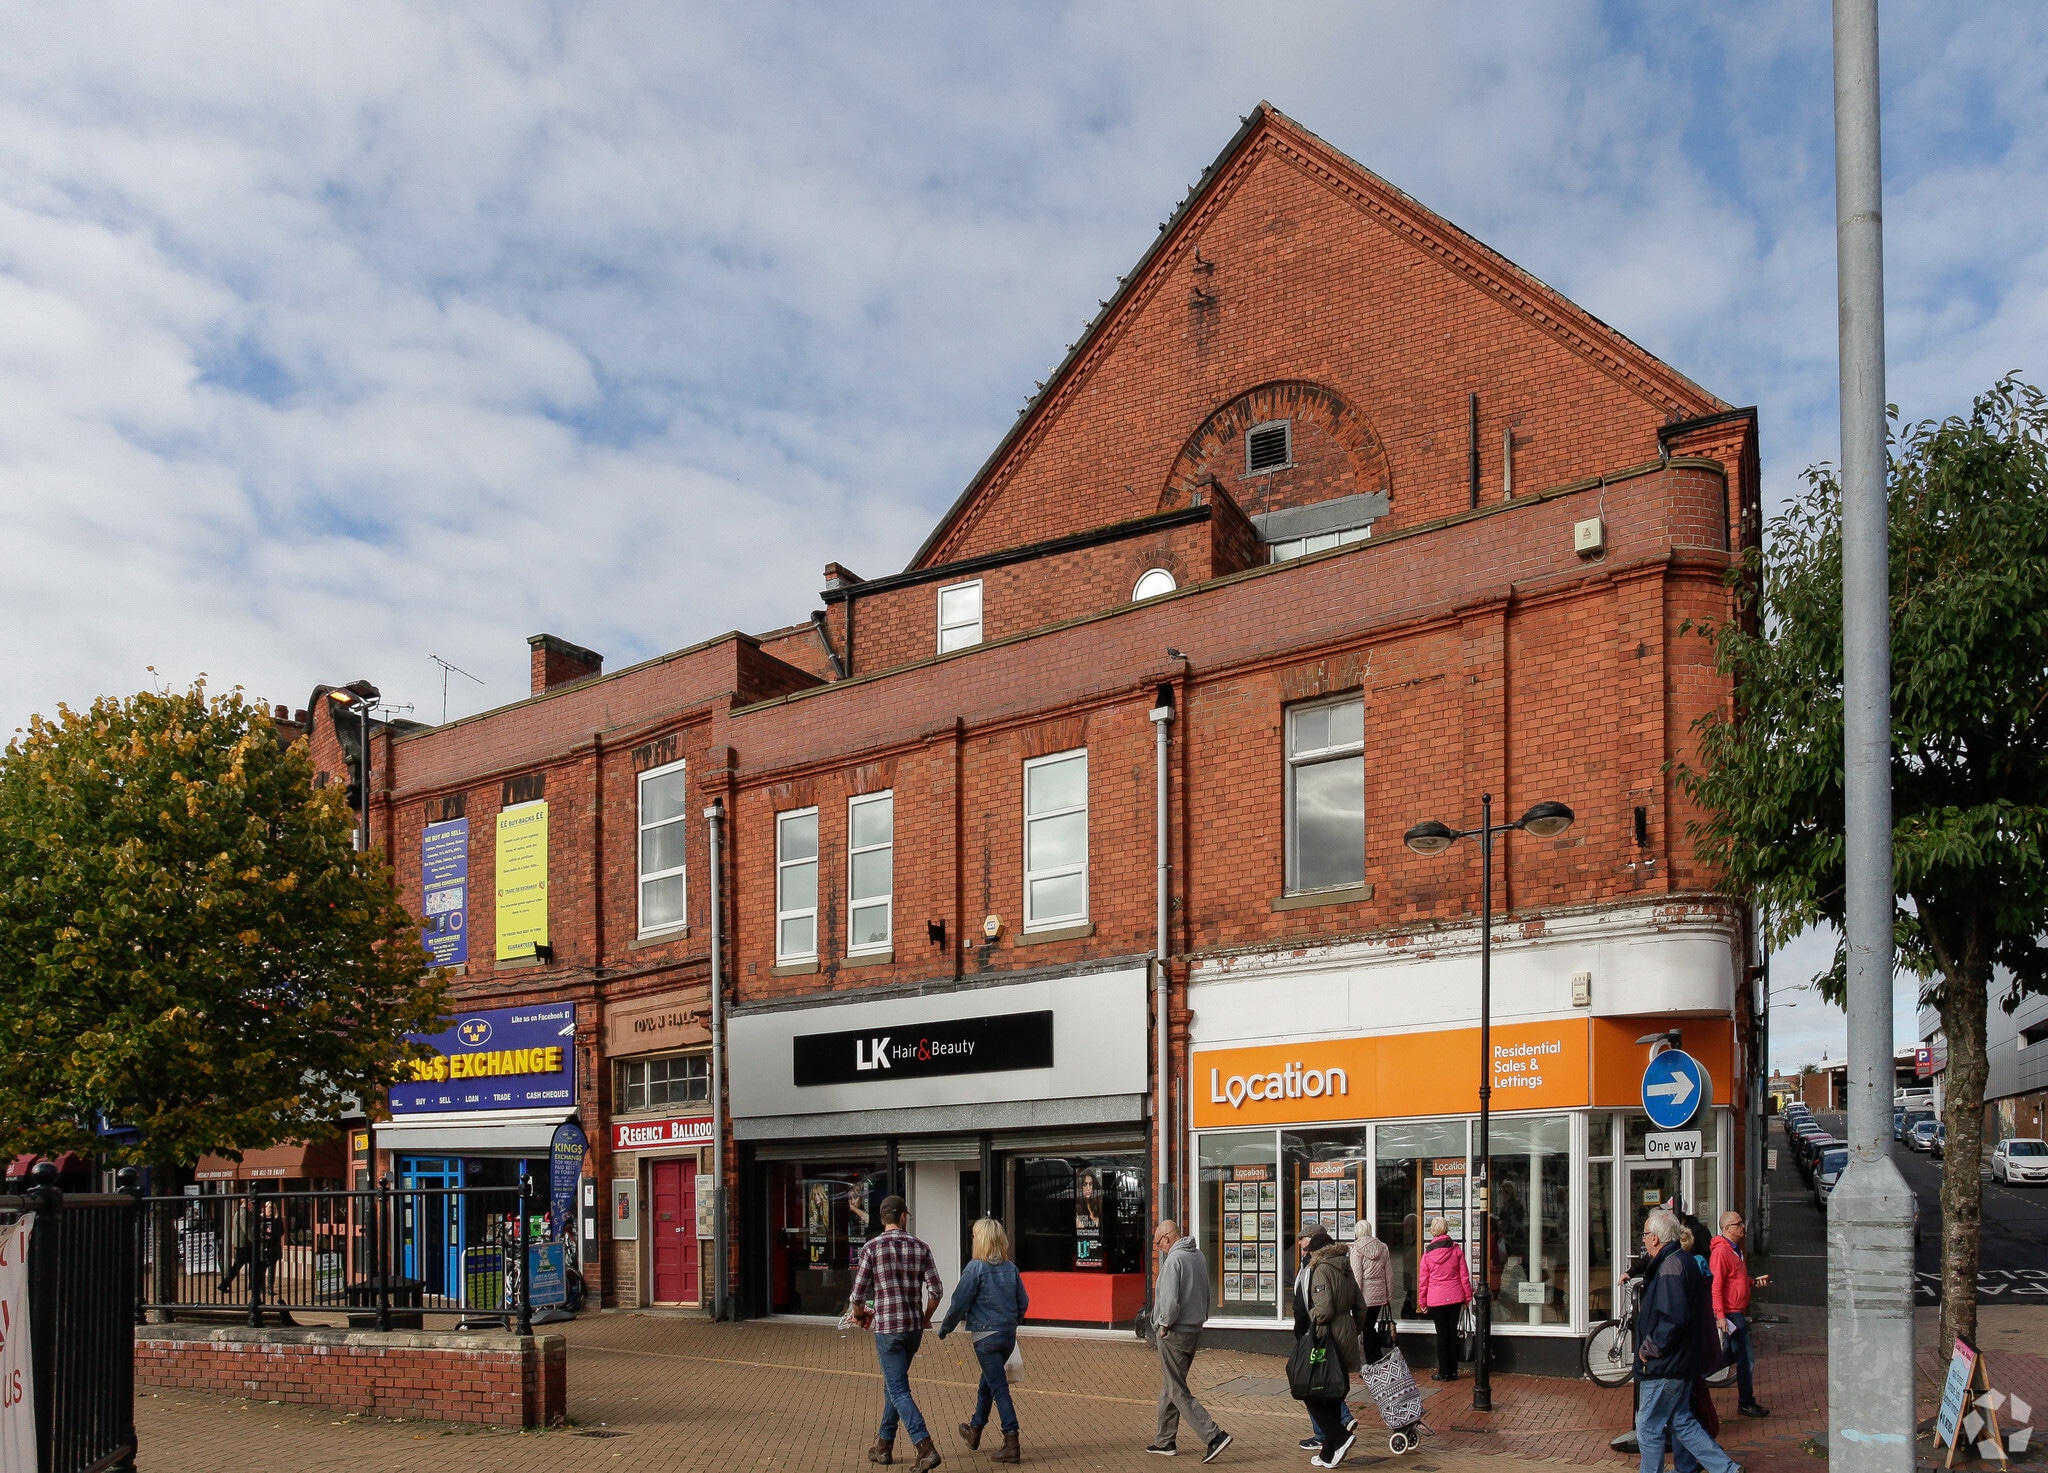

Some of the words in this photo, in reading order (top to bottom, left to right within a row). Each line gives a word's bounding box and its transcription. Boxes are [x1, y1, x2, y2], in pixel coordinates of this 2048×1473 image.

[538, 1011, 563, 1021] Facebook
[634, 1014, 665, 1032] TOWN
[668, 1010, 699, 1026] HALL
[857, 1037, 891, 1070] LK
[1494, 1040, 1560, 1058] Residential
[1919, 1051, 1927, 1061] P
[450, 1046, 562, 1079] EXCHANGE
[1494, 1060, 1526, 1073] Sales
[1530, 1058, 1539, 1070] &
[1211, 1062, 1348, 1109] Location
[1494, 1075, 1543, 1088] Lettings
[526, 1092, 541, 1100] CASH
[542, 1090, 569, 1099] CHEQUES
[672, 1122, 714, 1139] BALLROO
[1648, 1140, 1670, 1152] One
[1674, 1140, 1696, 1152] way
[1235, 1167, 1264, 1179] Location
[1311, 1164, 1342, 1175] Location
[5, 1368, 22, 1408] us
